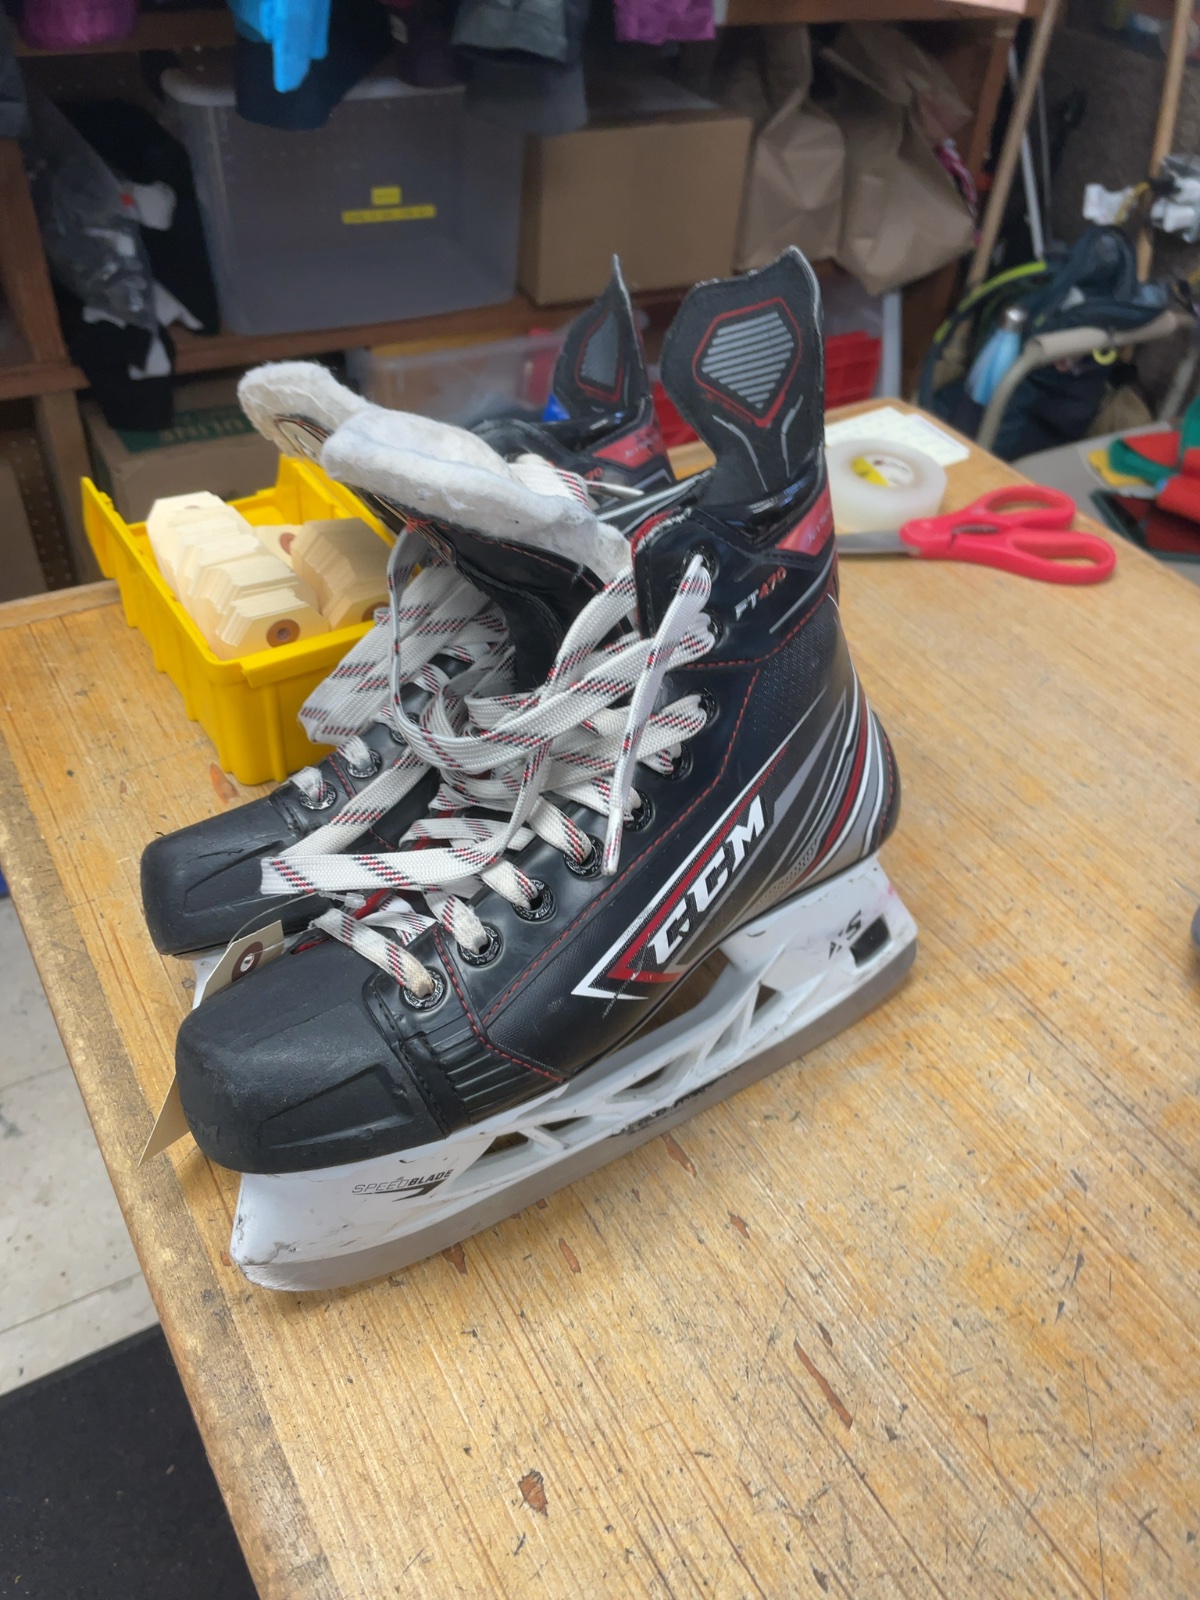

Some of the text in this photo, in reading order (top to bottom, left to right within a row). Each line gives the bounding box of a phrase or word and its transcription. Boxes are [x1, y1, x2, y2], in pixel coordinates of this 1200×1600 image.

[734, 566, 787, 621] FT470
[648, 794, 765, 965] CCM
[351, 1168, 455, 1194] SPEEDBLADE
